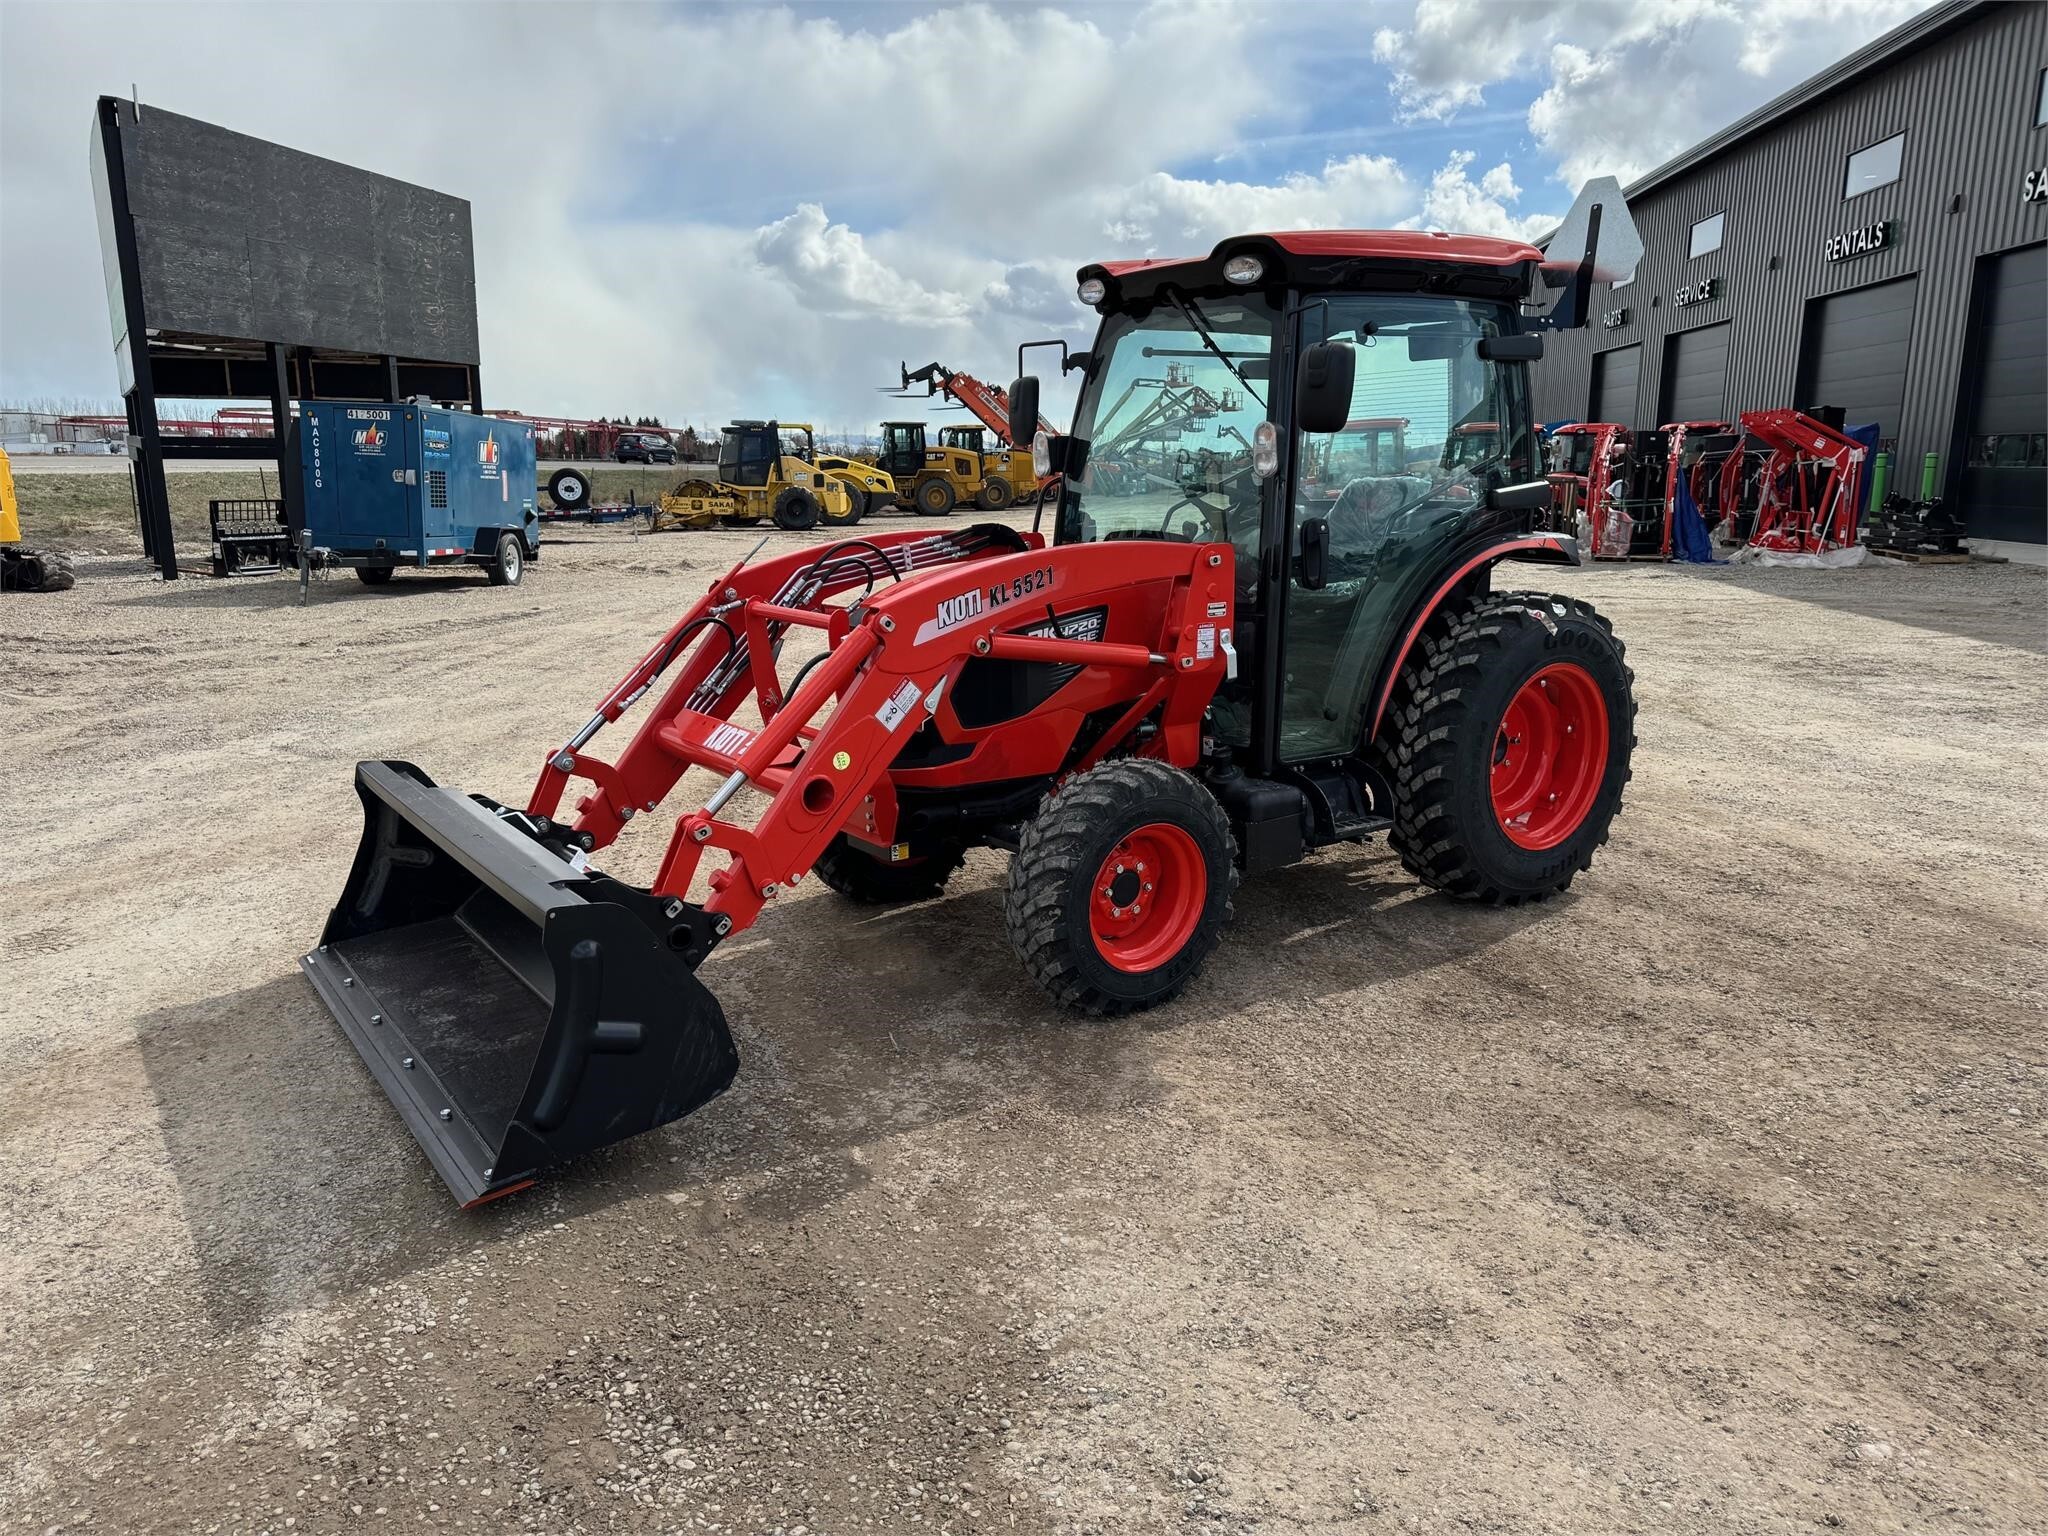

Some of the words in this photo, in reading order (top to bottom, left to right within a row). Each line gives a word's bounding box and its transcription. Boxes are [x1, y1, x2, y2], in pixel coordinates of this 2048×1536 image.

[2023, 168, 2048, 202] SA
[1825, 221, 1884, 262] RENTALS
[1675, 280, 1710, 307] SERVICE
[1603, 309, 1622, 326] PARTS
[937, 587, 983, 630] KIOTI
[702, 722, 751, 756] KIOTI
